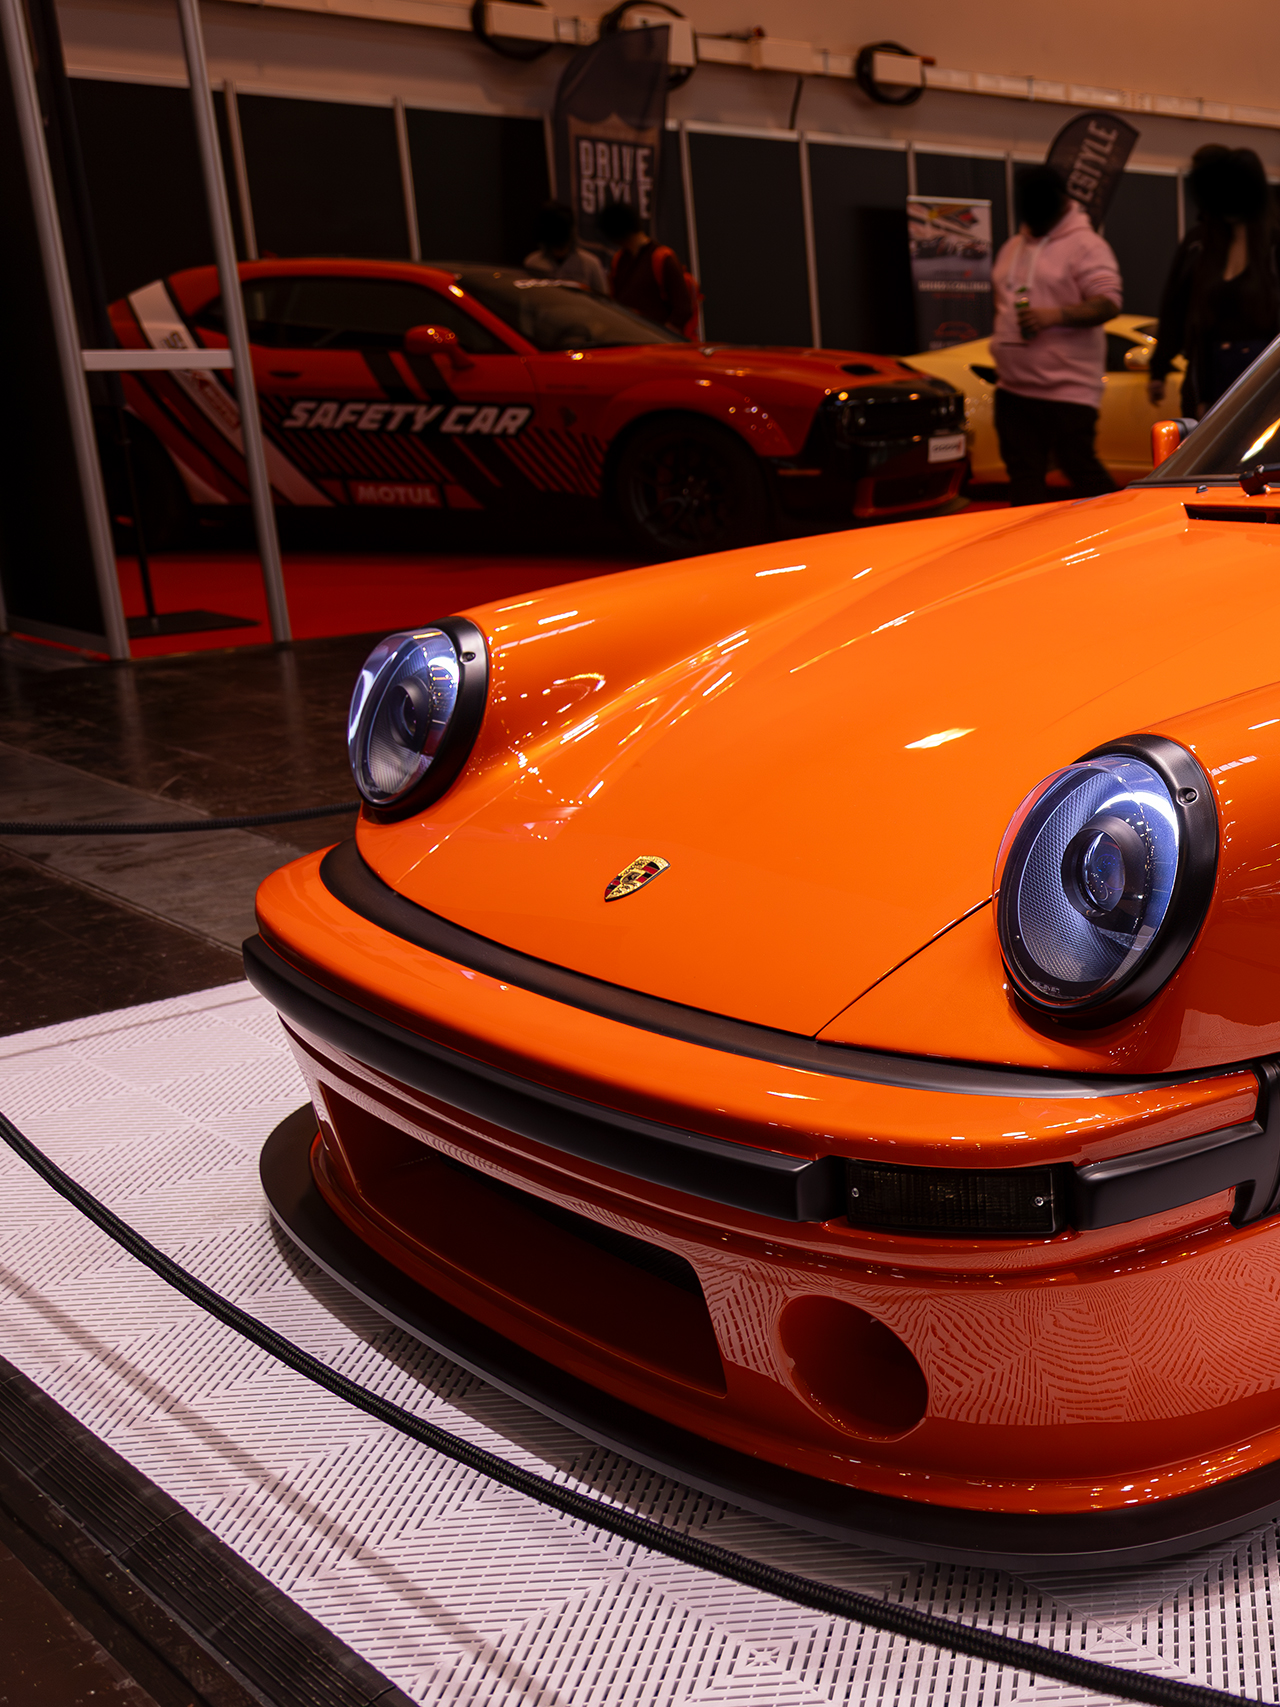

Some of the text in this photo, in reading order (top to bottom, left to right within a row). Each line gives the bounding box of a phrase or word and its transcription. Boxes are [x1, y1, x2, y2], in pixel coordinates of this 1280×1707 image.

[578, 139, 653, 184] DRIVE
[1065, 119, 1119, 202] ESTYLE
[281, 400, 447, 434] SAFETY
[439, 404, 533, 437] CAR
[357, 484, 438, 506] MOTUL
